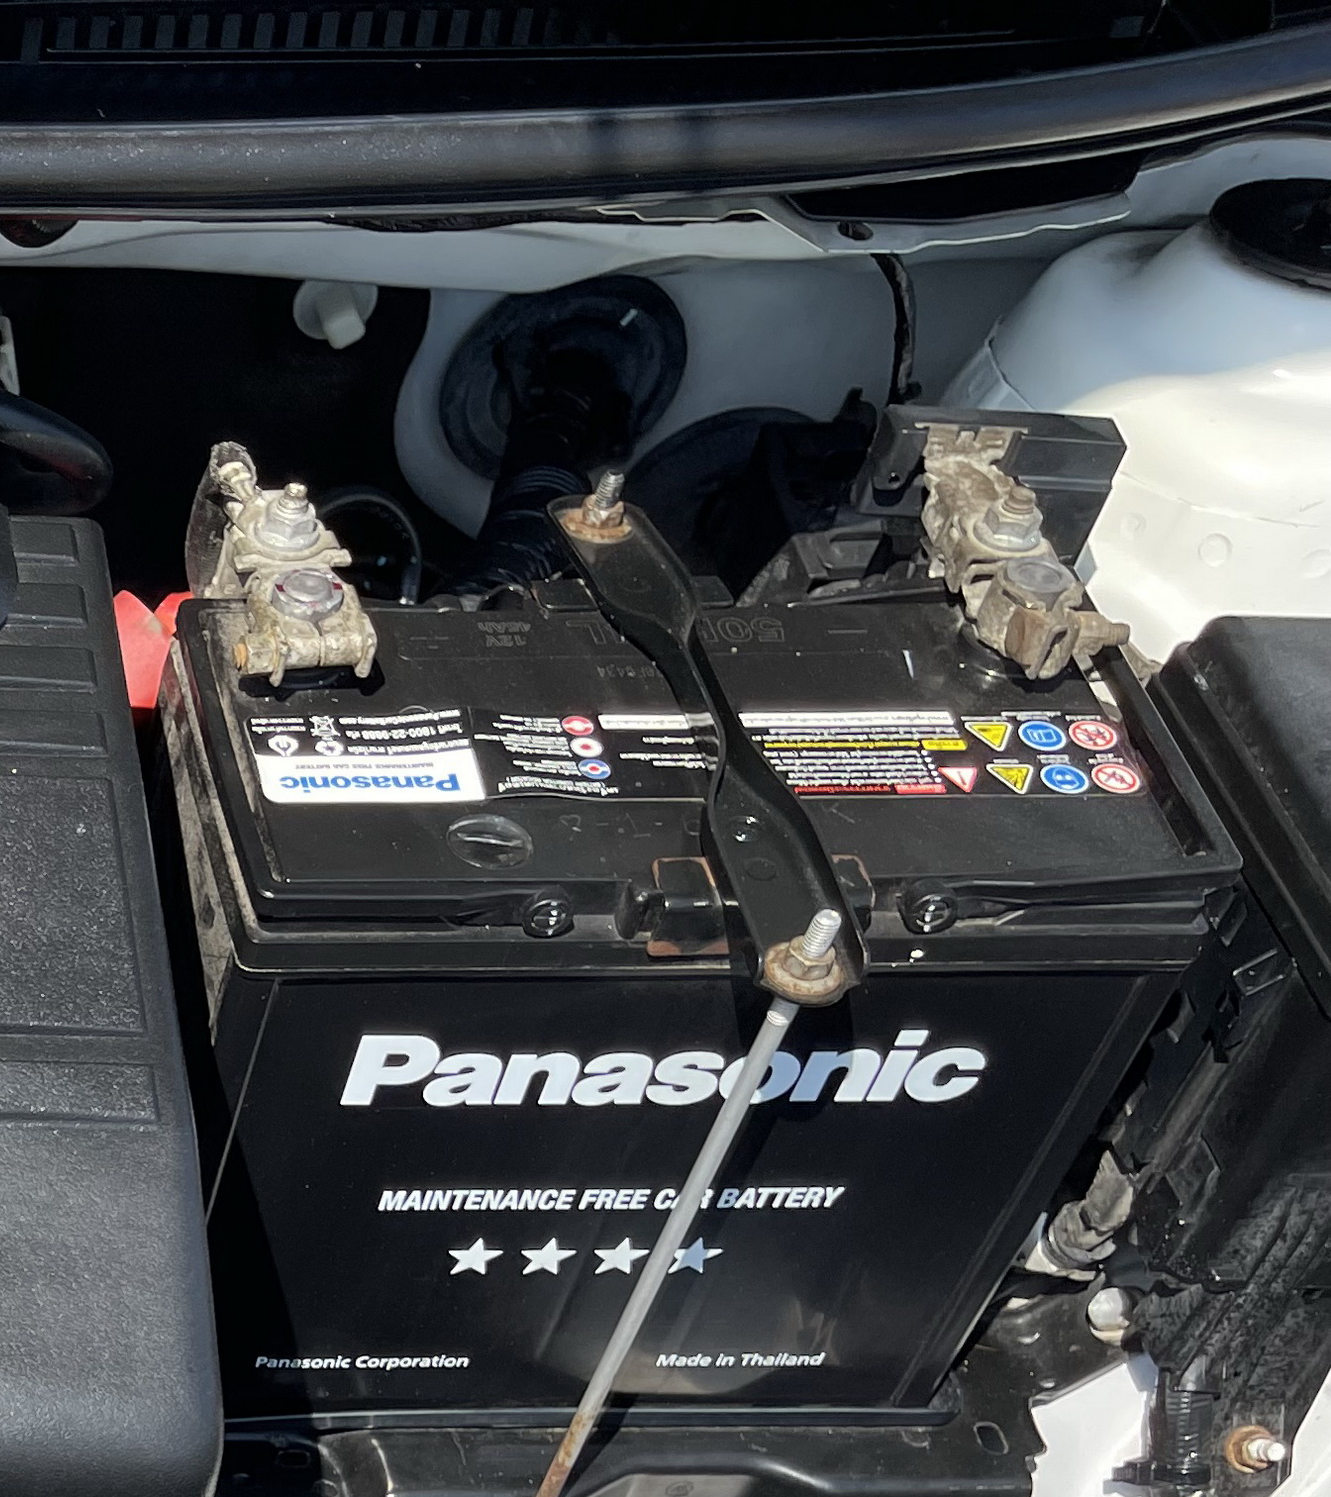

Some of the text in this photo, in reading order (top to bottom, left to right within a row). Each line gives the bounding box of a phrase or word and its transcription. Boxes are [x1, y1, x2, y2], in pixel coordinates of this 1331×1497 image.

[279, 774, 461, 793] Panasonic
[340, 1029, 987, 1106] Panasonic
[377, 1189, 572, 1212] MAINTENANCE
[578, 1188, 651, 1211] FREE
[716, 1186, 846, 1210] BATTERY
[255, 1354, 469, 1371] Panasonic Corporation
[655, 1351, 827, 1368] Made in Thailand
